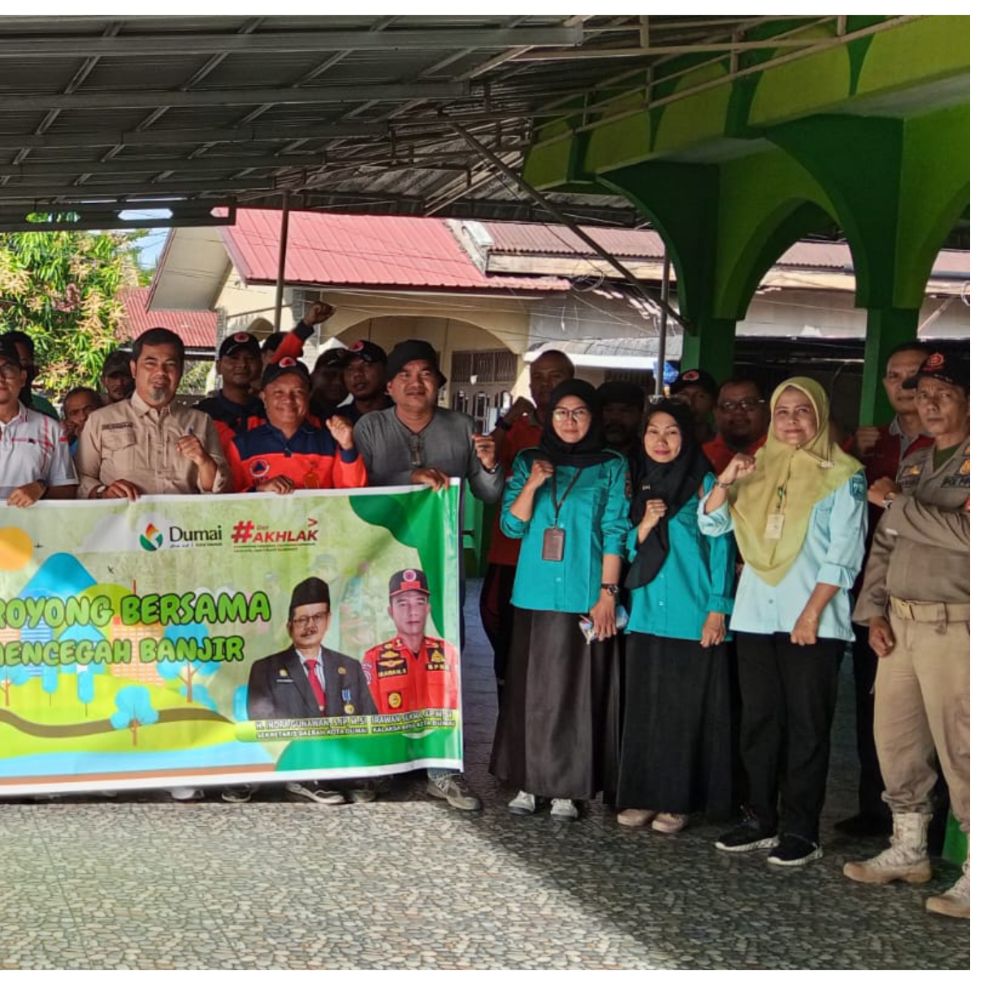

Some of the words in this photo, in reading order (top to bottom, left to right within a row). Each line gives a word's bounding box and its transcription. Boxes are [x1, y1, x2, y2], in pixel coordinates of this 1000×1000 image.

[169, 525, 223, 542] Dumai
[120, 591, 271, 626] BERSAMA
[138, 634, 245, 663] BANJIR
